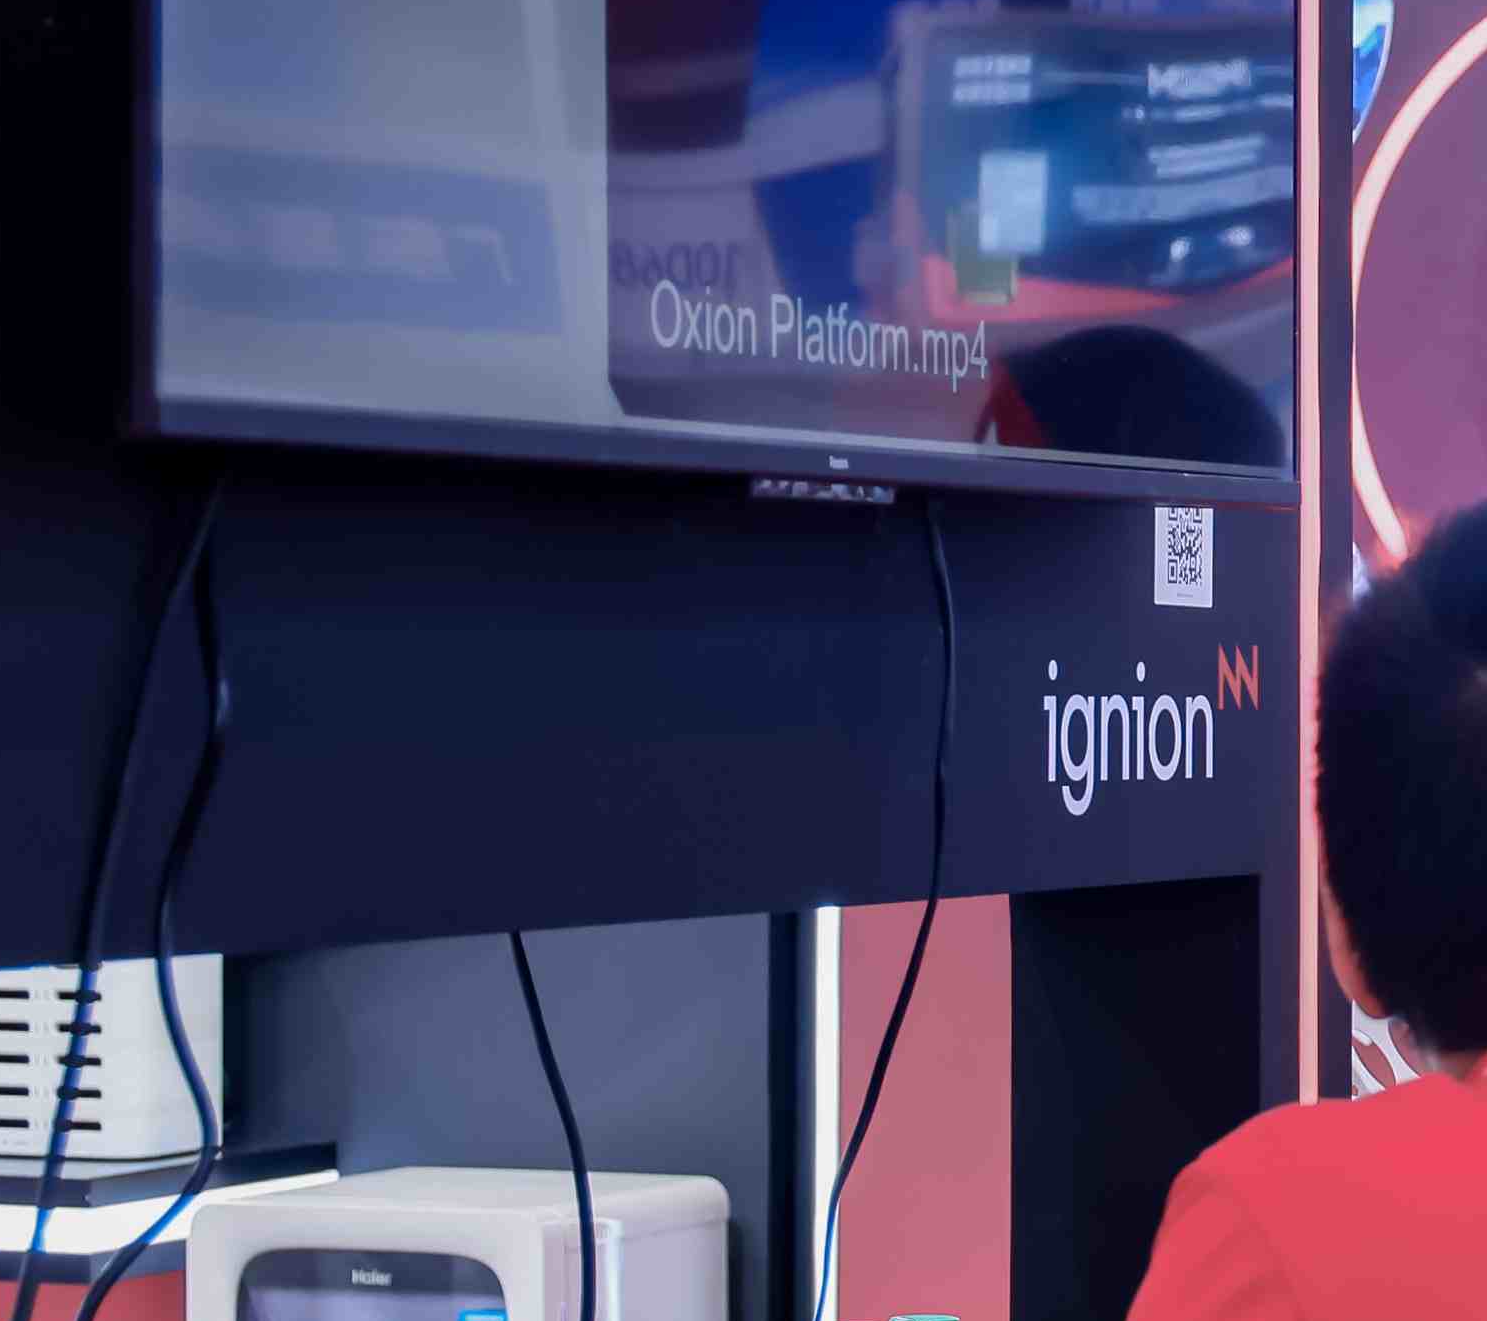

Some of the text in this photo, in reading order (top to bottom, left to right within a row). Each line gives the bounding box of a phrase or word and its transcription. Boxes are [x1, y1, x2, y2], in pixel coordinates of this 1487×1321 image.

[650, 278, 989, 394] Oxion Platform.mp4
[1043, 659, 1216, 817] ignion
